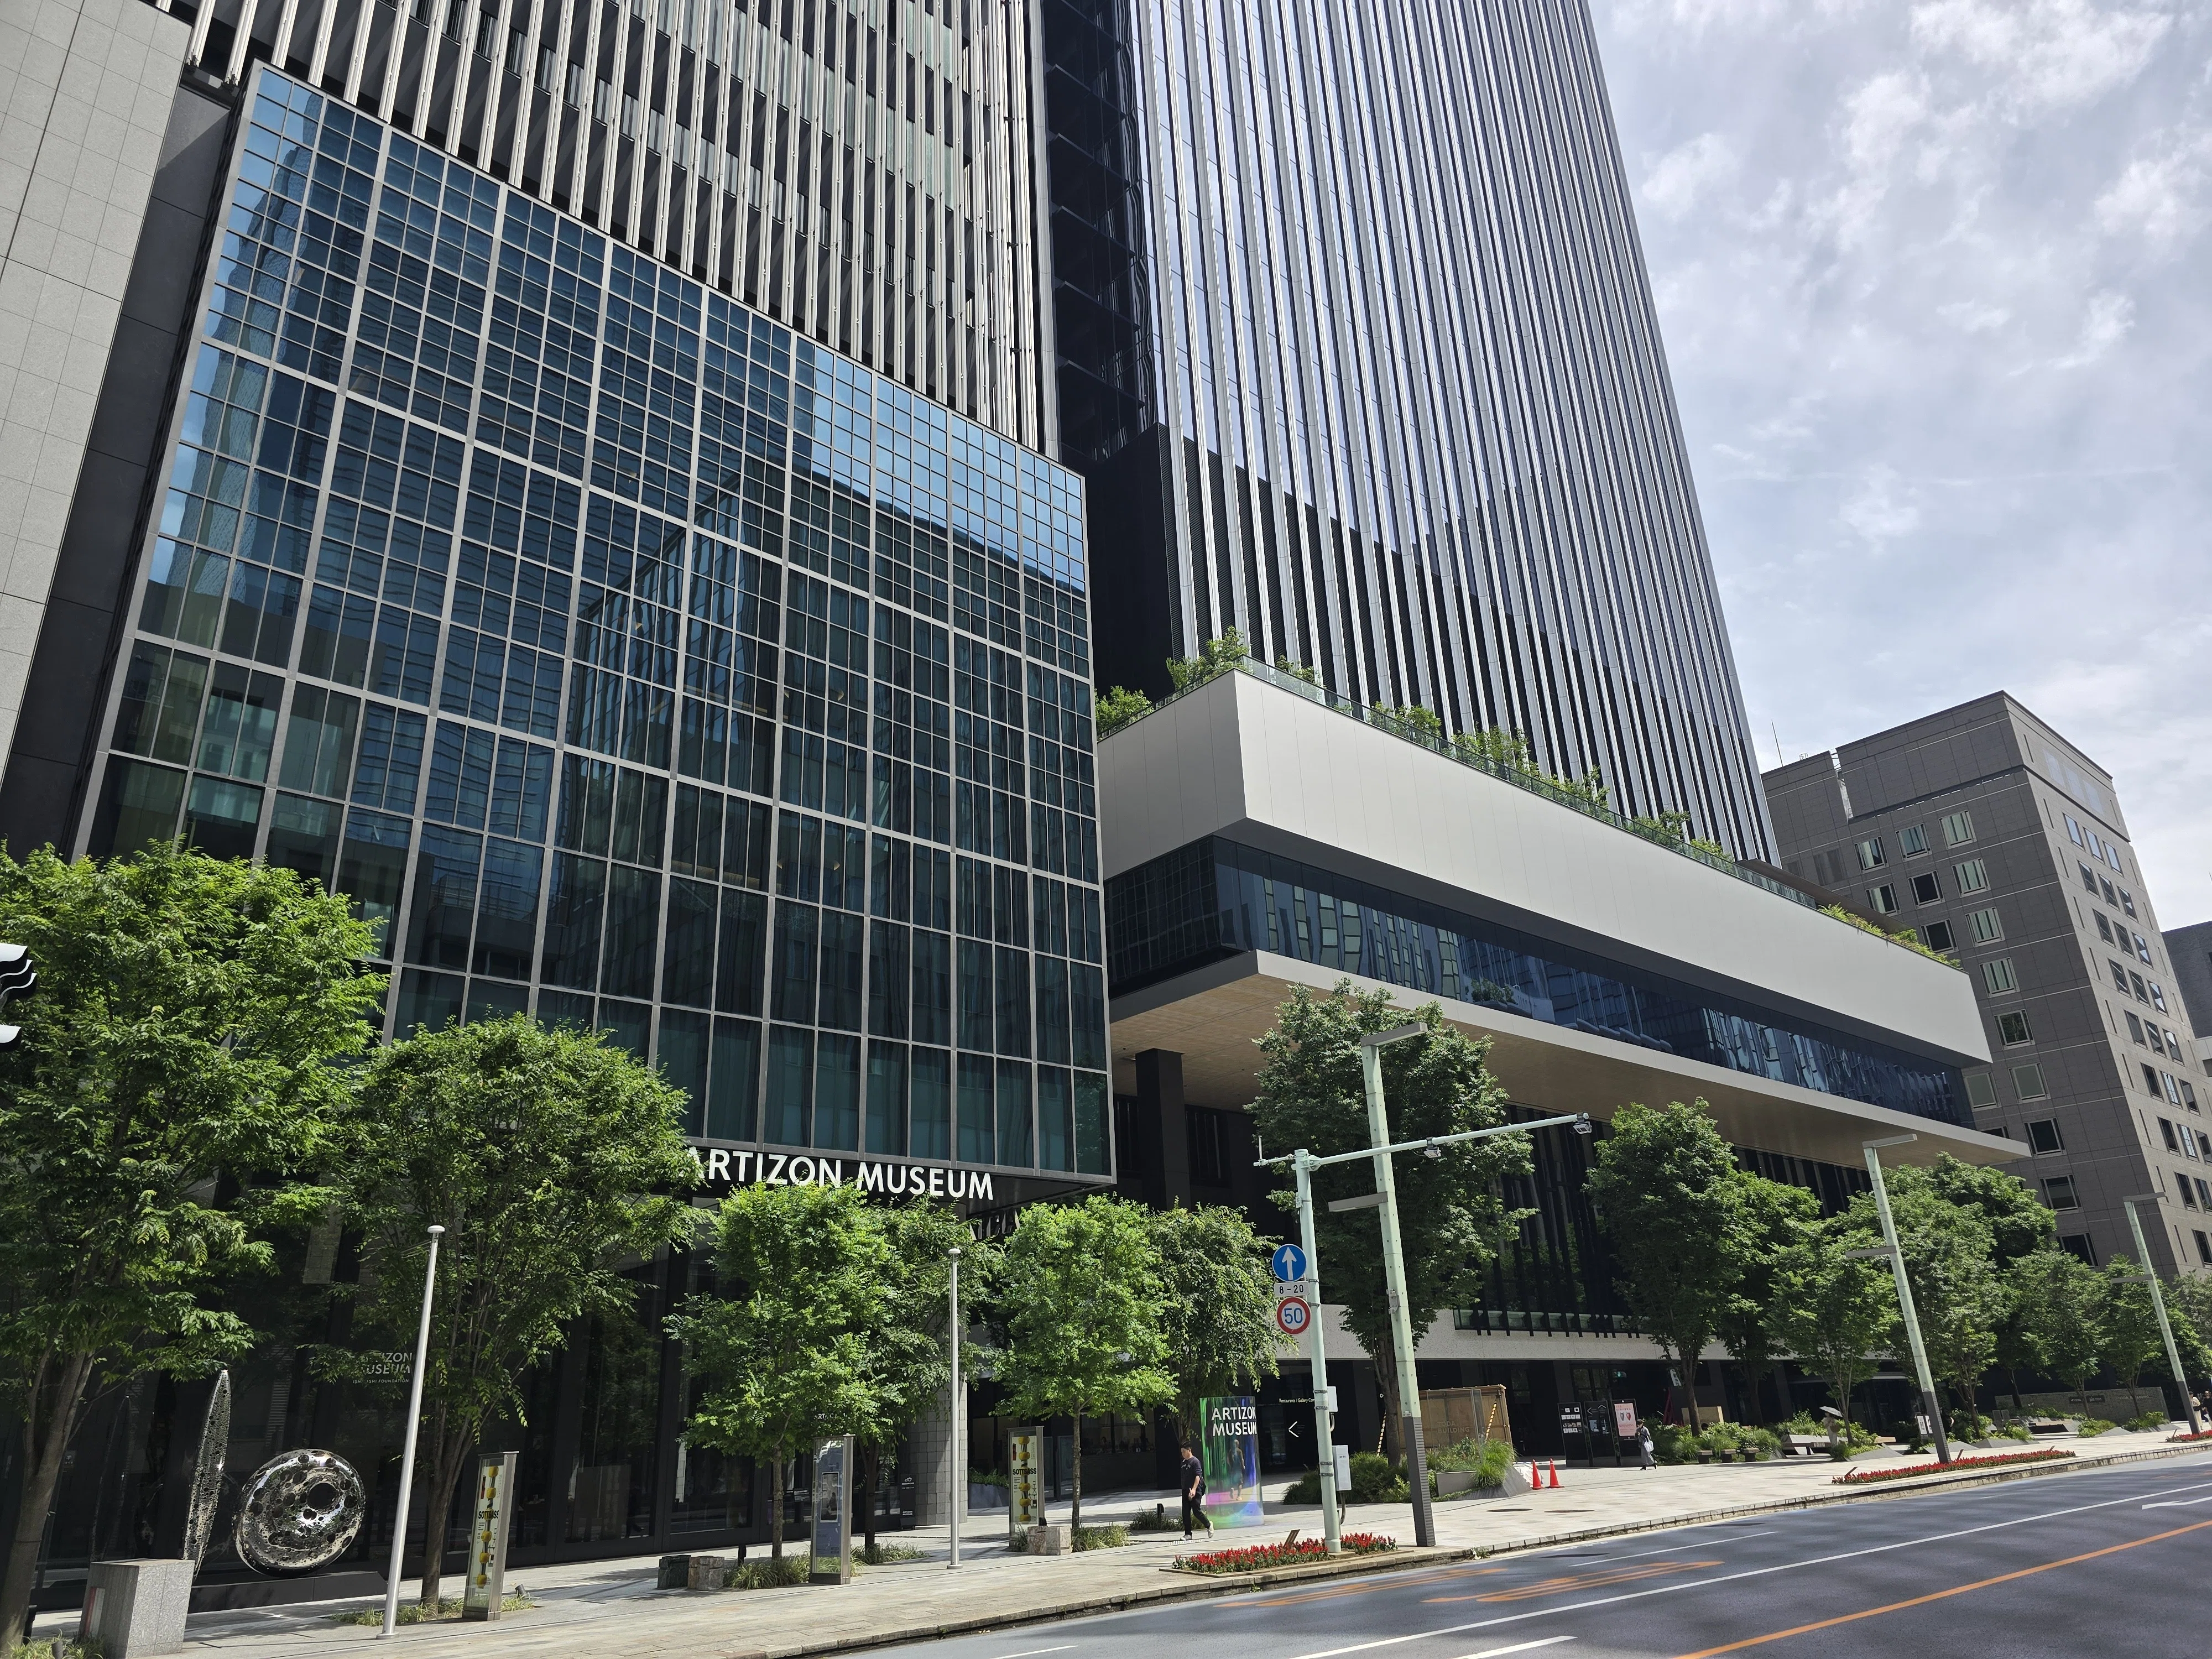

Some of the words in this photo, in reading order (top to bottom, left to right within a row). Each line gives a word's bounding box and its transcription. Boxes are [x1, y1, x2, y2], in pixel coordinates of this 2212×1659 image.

[857, 1161, 993, 1201] MUSEUM
[1284, 1307, 1303, 1324] 50
[362, 1364, 410, 1374] USEUM
[1211, 1406, 1256, 1421] ARTIZON
[1212, 1422, 1257, 1437] MUSEUM
